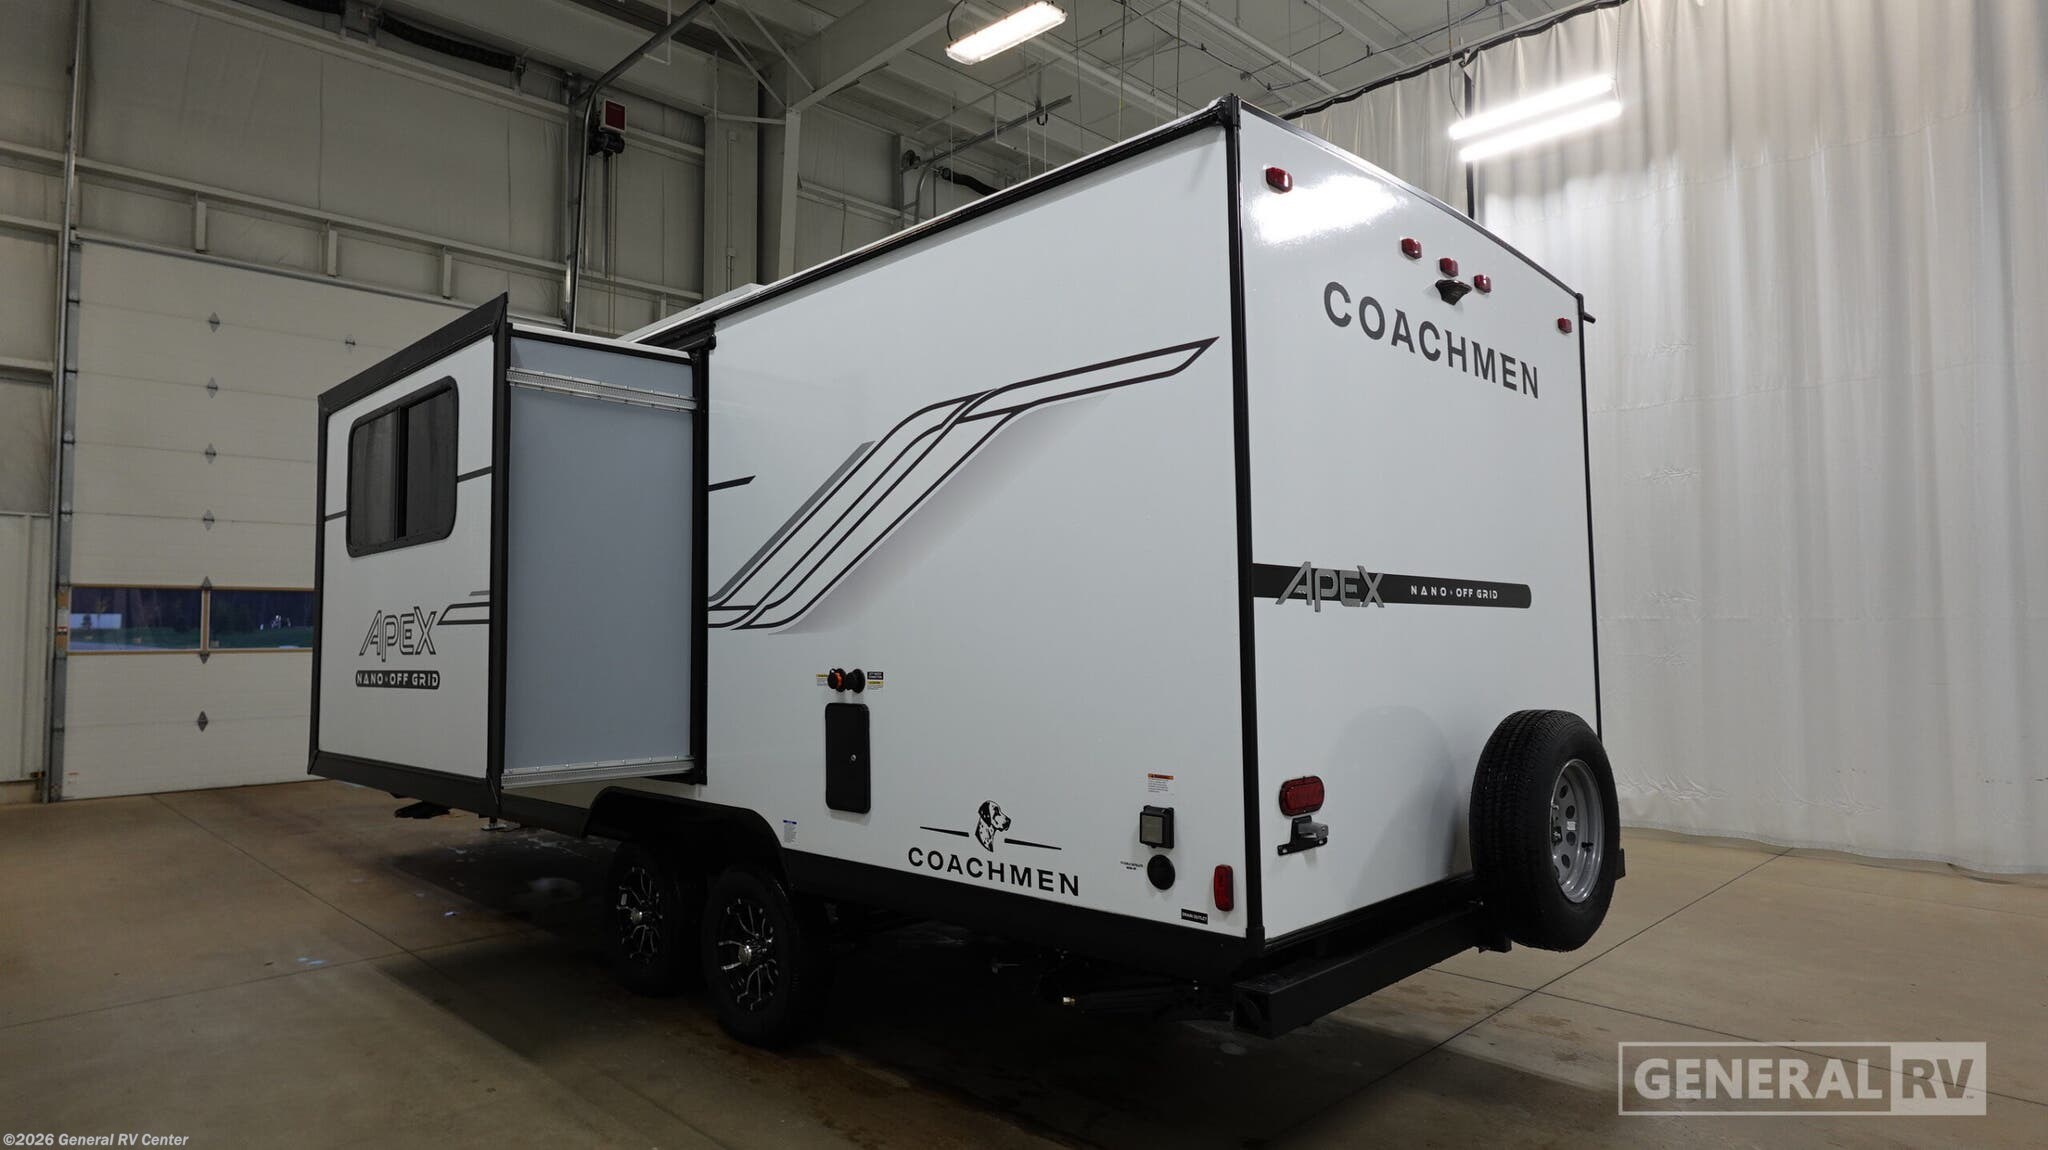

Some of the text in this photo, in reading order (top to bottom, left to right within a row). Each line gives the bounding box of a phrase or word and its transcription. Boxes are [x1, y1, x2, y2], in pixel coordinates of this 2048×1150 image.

[1323, 281, 1539, 400] COACHMEN
[1275, 561, 1385, 613] APEX
[1410, 584, 1498, 600] NANO OFF GRID
[359, 606, 437, 663] APEX
[357, 672, 439, 687] NANO OFF GRID
[908, 847, 1079, 897] COACHMEN
